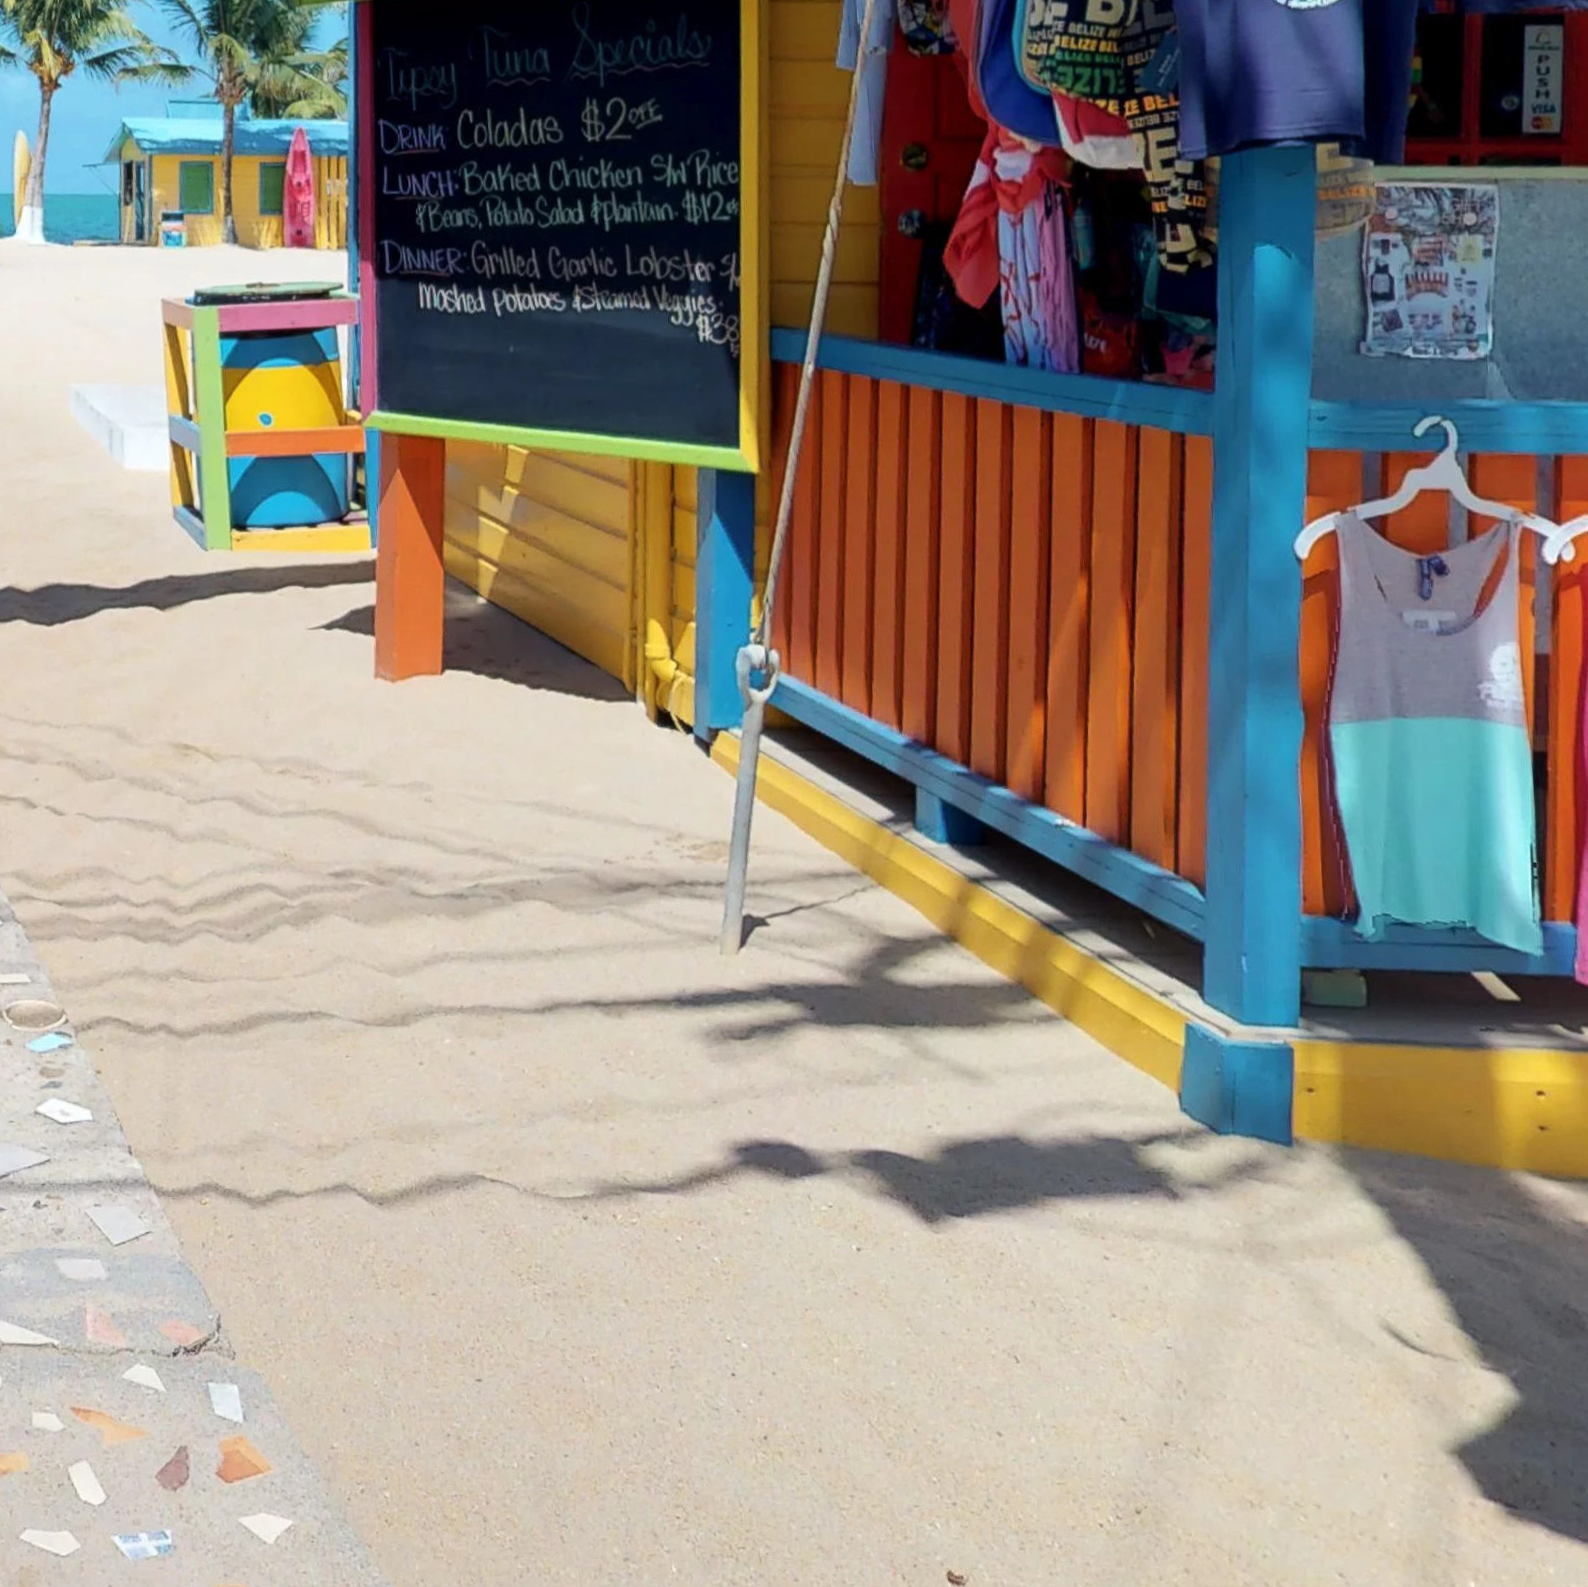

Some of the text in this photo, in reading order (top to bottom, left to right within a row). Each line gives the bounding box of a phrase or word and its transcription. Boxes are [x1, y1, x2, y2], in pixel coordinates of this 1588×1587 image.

[383, 1, 712, 111] Tipsy Tuna Specials
[1535, 54, 1551, 100] PUSH
[457, 107, 564, 150] Coladas
[461, 160, 541, 196] Baked
[548, 156, 644, 192] Chicken
[692, 149, 740, 189] Rice
[483, 194, 536, 227] Potato
[536, 195, 585, 229] Salad
[470, 240, 541, 281] Grilled
[547, 242, 619, 282] Garlic
[625, 243, 713, 283] Lobster
[418, 282, 487, 314] Mashed
[581, 281, 651, 312] Steamed
